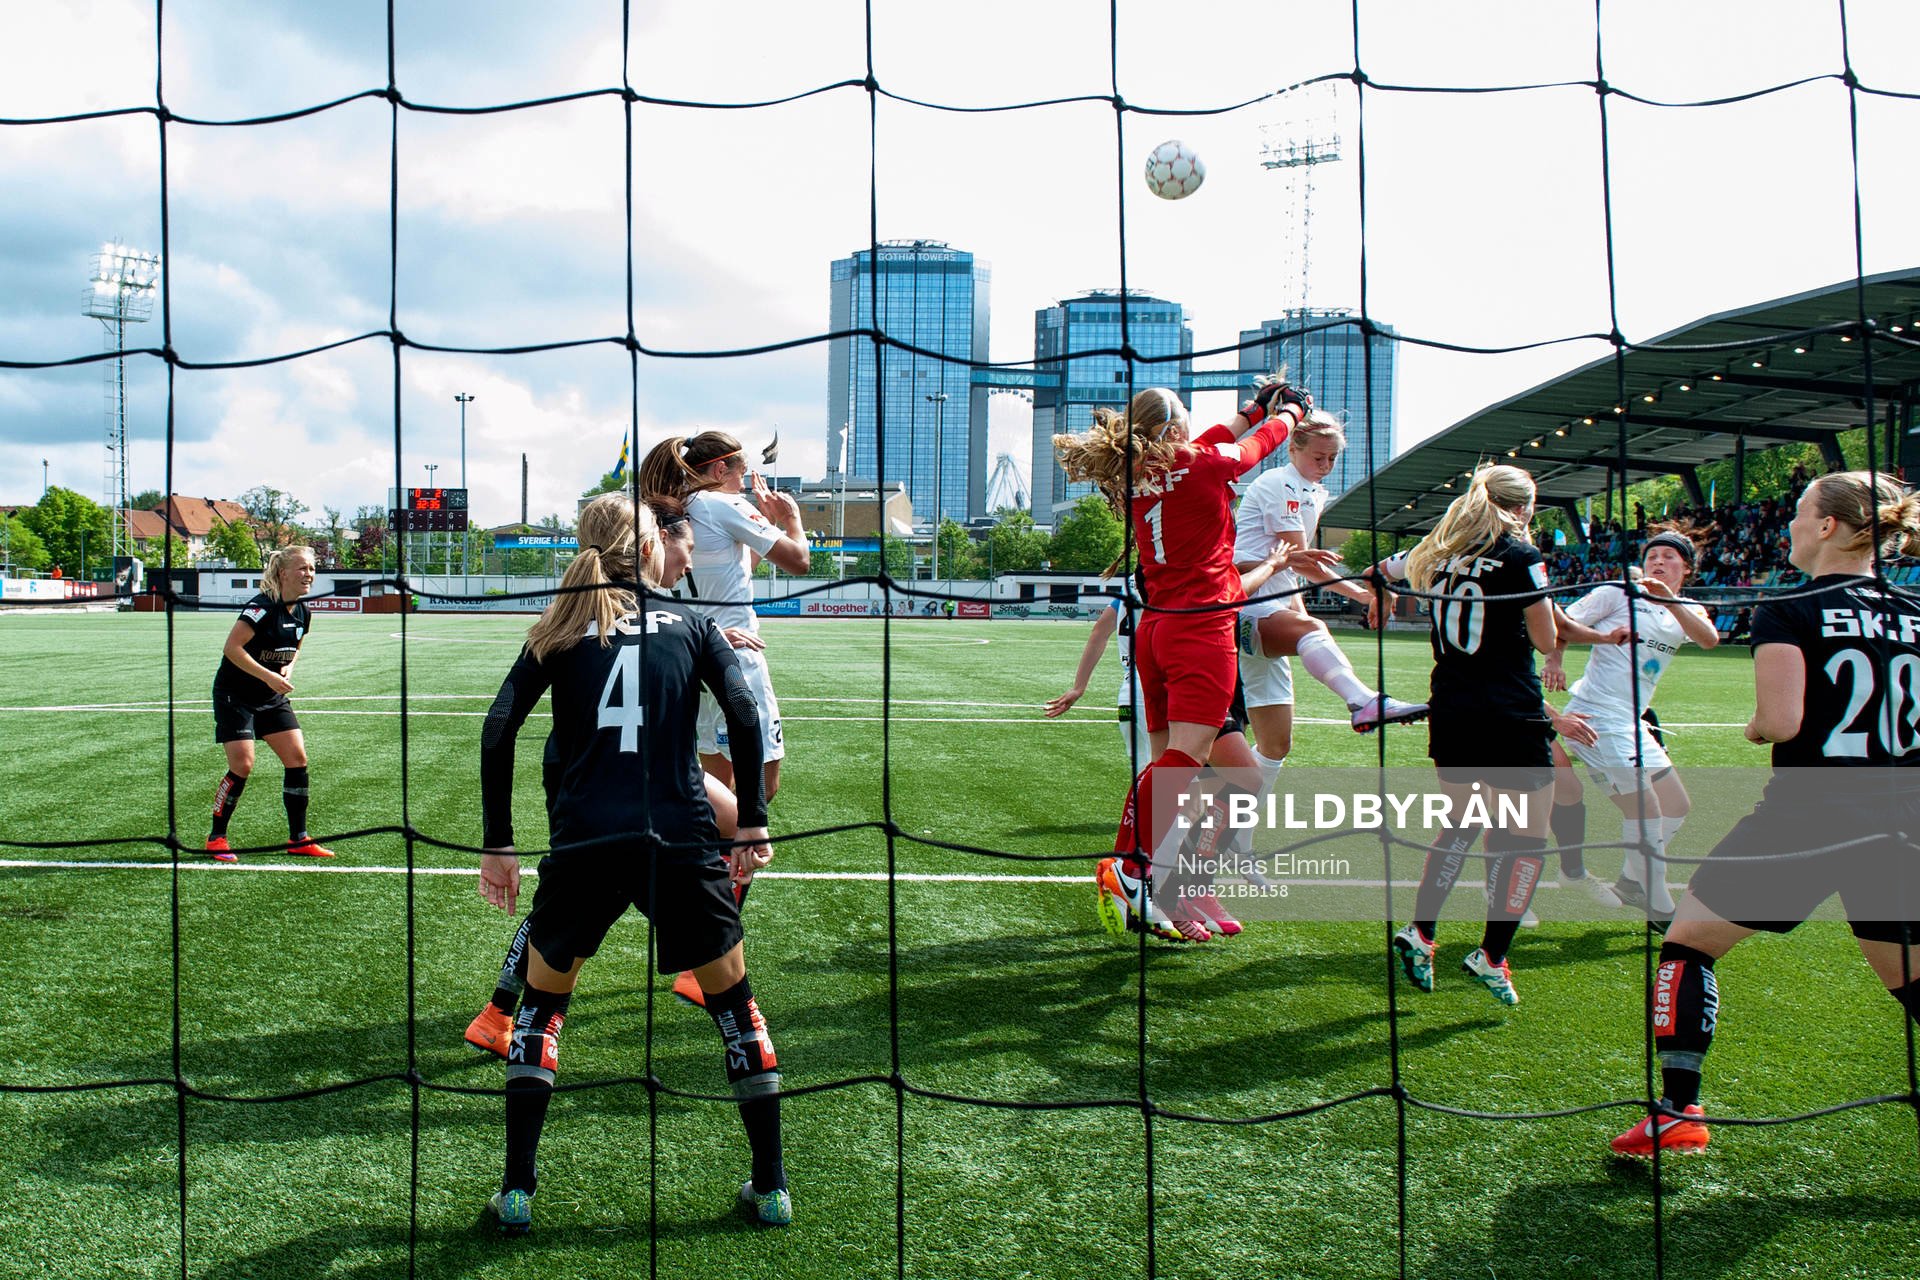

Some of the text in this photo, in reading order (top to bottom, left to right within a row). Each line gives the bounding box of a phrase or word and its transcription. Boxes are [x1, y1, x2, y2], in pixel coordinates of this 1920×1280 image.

[878, 253, 956, 261] GOTHIA TOWERS
[1131, 468, 1189, 498] KF
[518, 536, 551, 545] SVERIGE
[815, 539, 821, 548] 6
[823, 539, 843, 548] JUNI
[1144, 500, 1167, 564] 1
[1432, 555, 1504, 578] KF
[808, 603, 868, 614] all together
[1431, 578, 1485, 655] 10
[1646, 639, 1678, 656] SIGM
[597, 645, 644, 753] 4
[1822, 648, 1920, 757] 20
[1510, 860, 1536, 909] Stavdal
